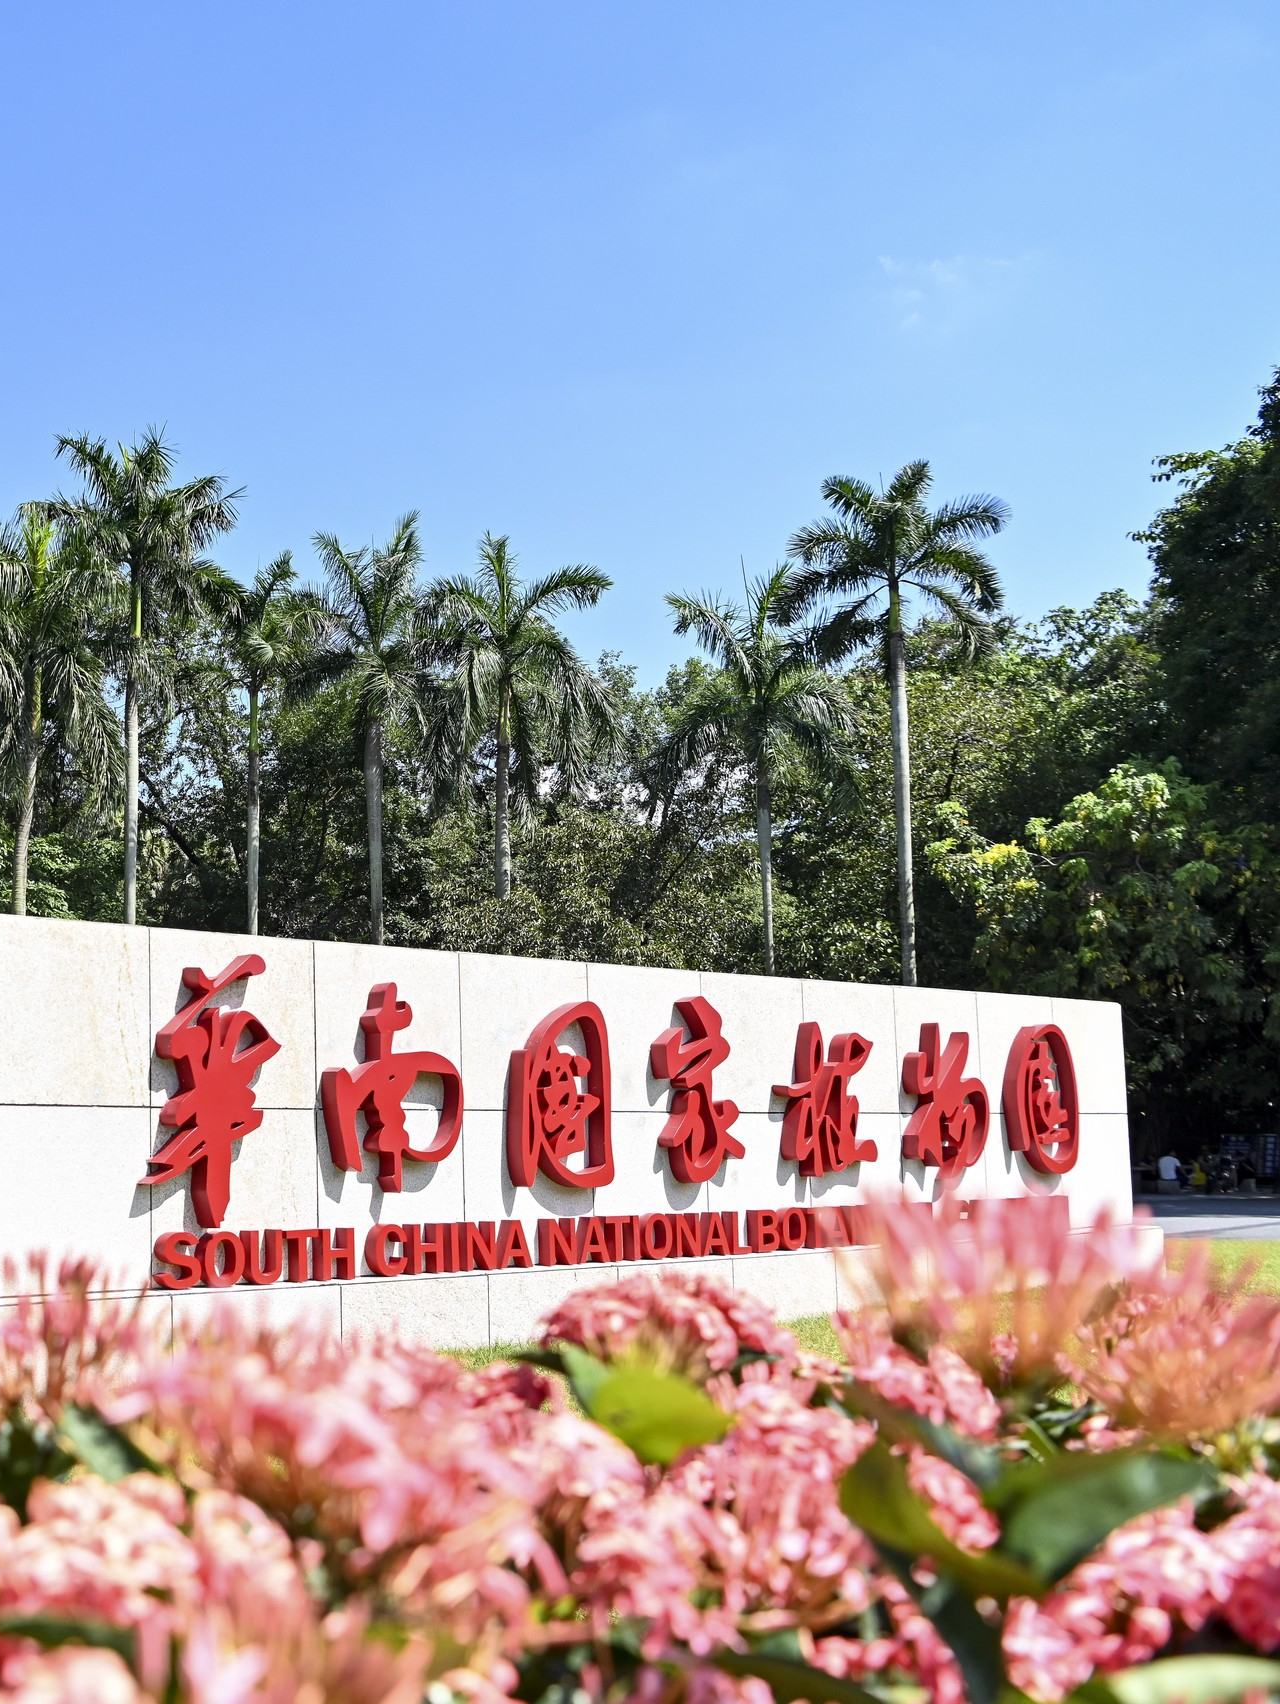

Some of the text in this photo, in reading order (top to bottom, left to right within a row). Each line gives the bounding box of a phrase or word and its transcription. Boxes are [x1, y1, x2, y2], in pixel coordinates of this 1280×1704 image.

[152, 1227, 355, 1290] SOUTH
[363, 1219, 534, 1278] CHINA
[536, 1210, 752, 1268] NATIONAL
